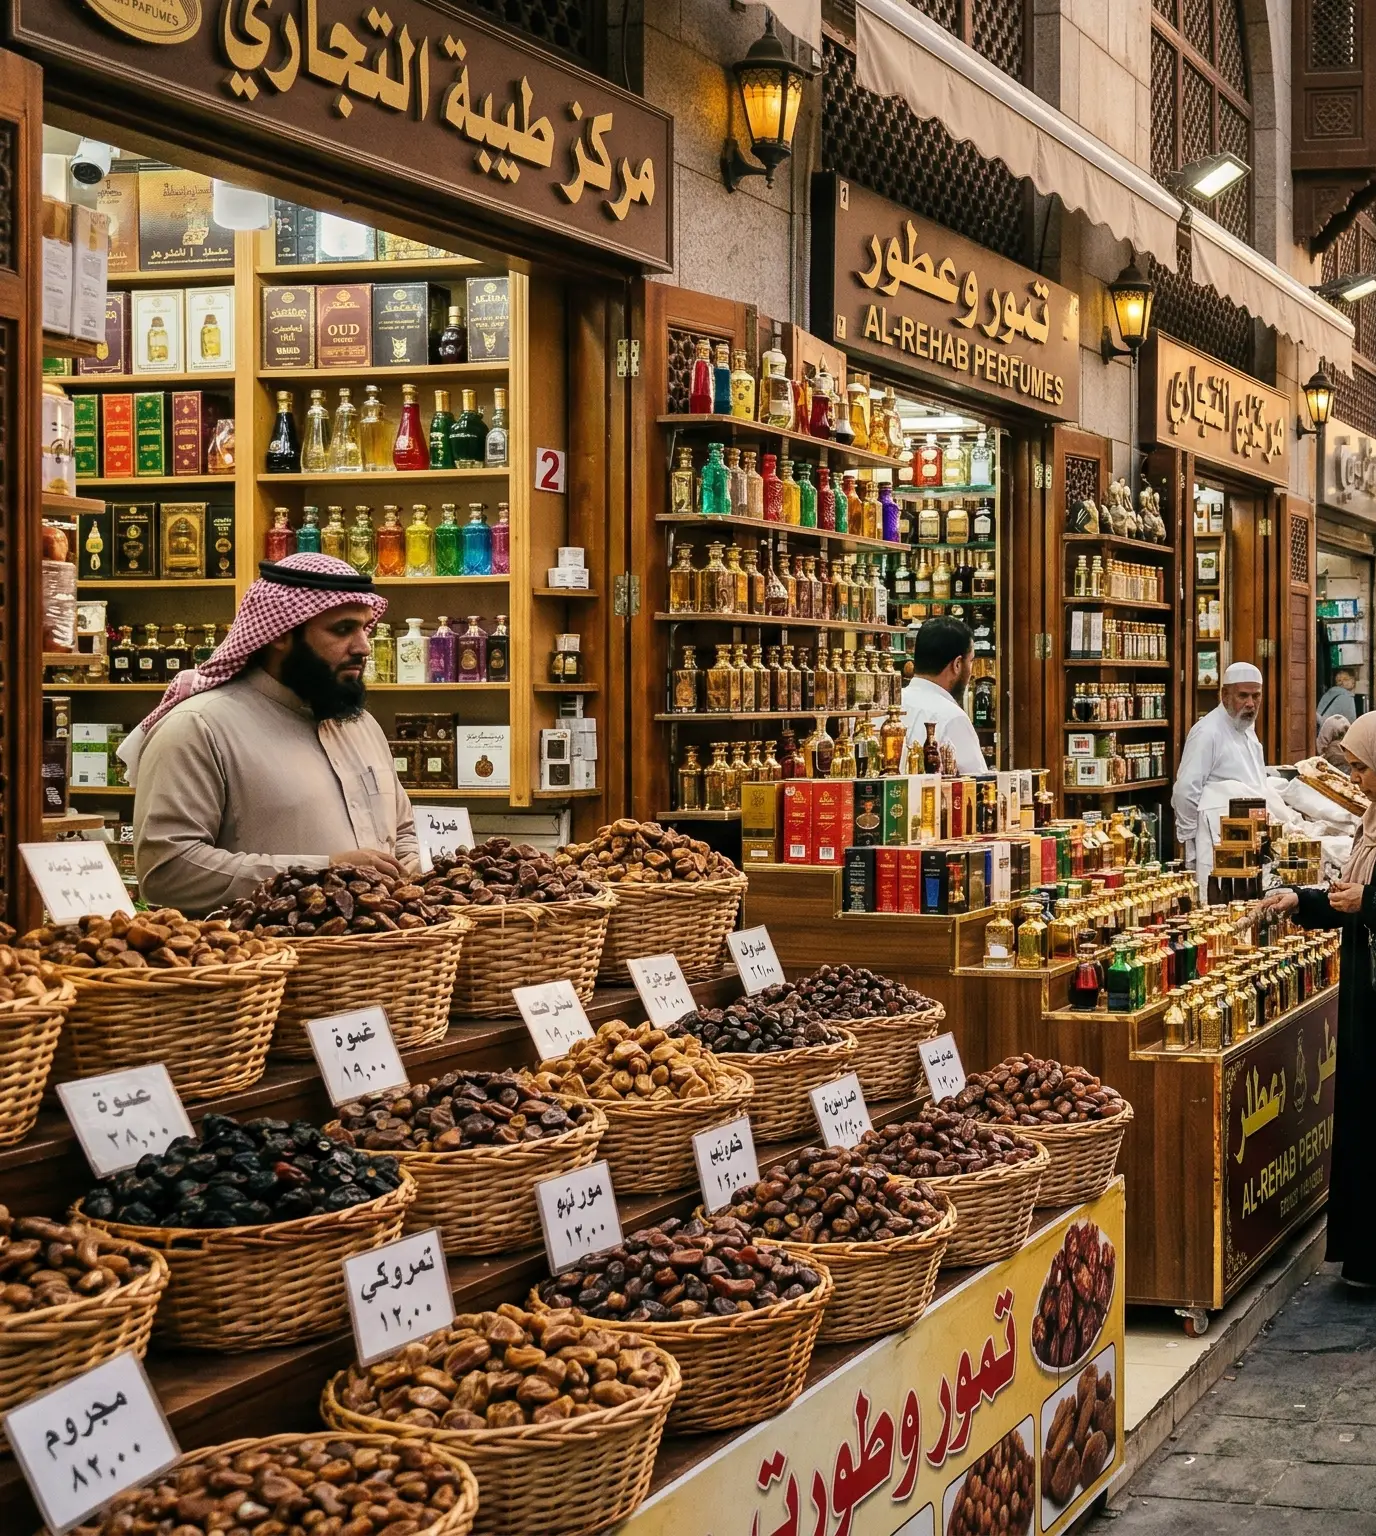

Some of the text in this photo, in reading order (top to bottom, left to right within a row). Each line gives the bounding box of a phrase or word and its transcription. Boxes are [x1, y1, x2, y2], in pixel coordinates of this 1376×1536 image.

[222, 0, 655, 221] مركز طيبة التجاري
[327, 323, 360, 336] OUD
[863, 304, 1064, 406] AL-REHAB PERFUMES
[541, 450, 560, 490] 2
[1241, 1144, 1297, 1220] AL-REHAB
[925, 1286, 1017, 1468] تمور
